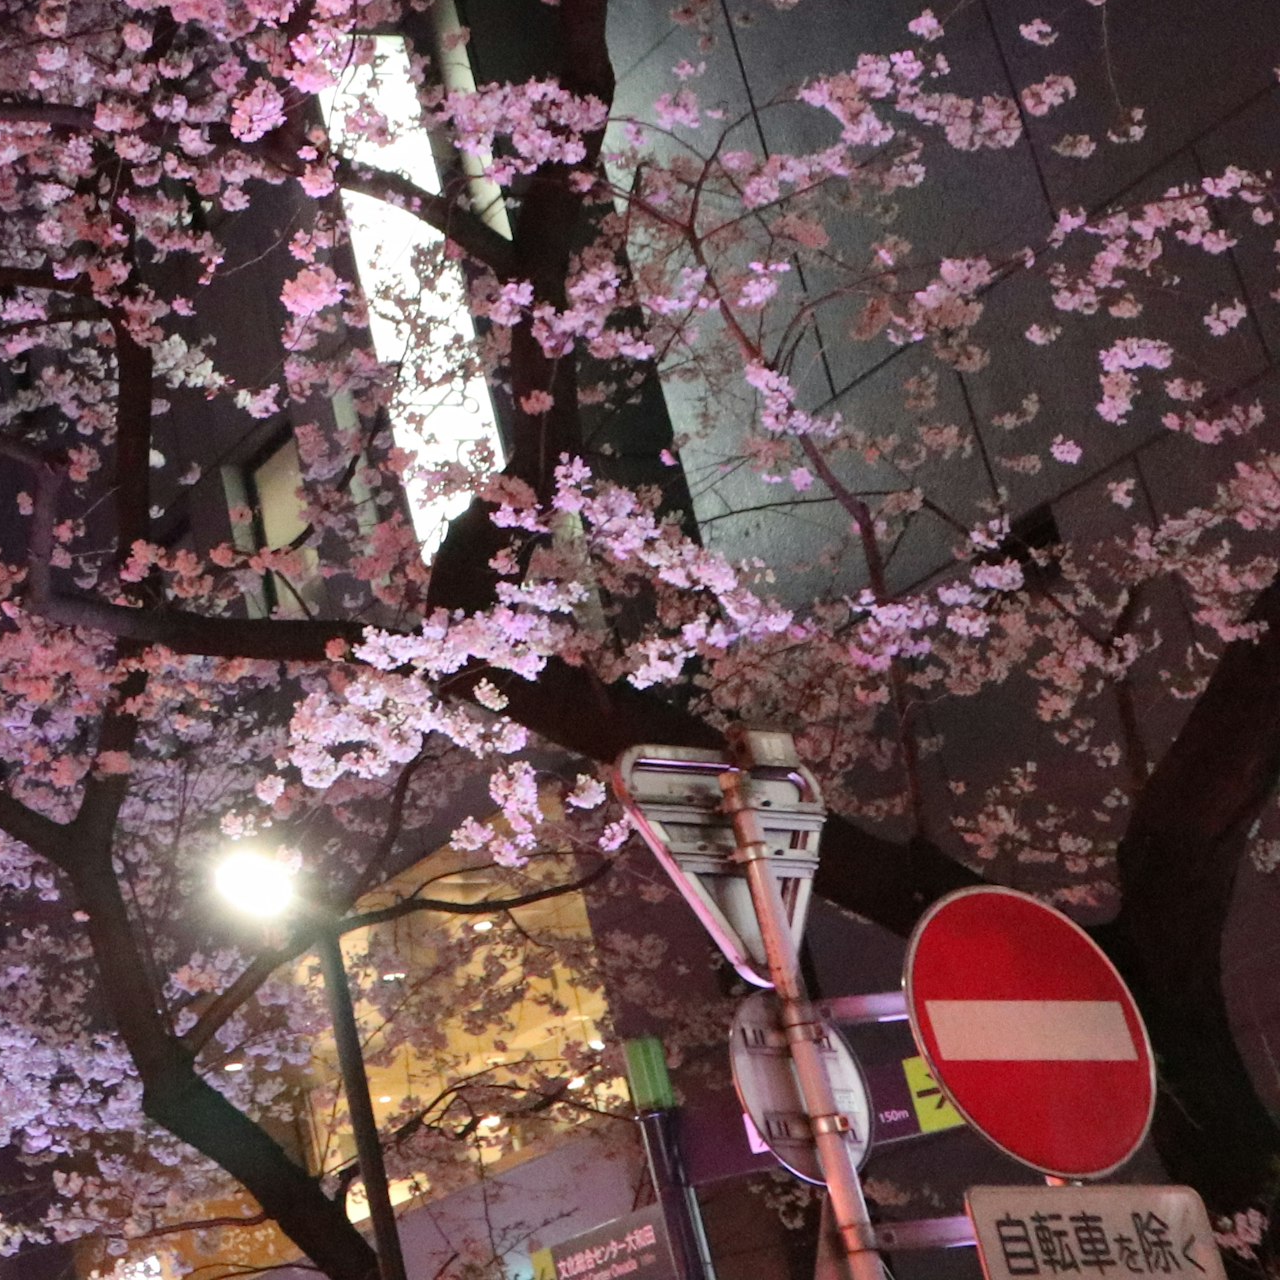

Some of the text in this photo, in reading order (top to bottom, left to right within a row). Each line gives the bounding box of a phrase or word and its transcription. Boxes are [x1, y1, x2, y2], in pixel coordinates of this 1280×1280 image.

[878, 1109, 910, 1123] 150m
[557, 1224, 657, 1280] 文化総合センター大和田
[996, 1210, 1206, 1276] 自転車を除く
